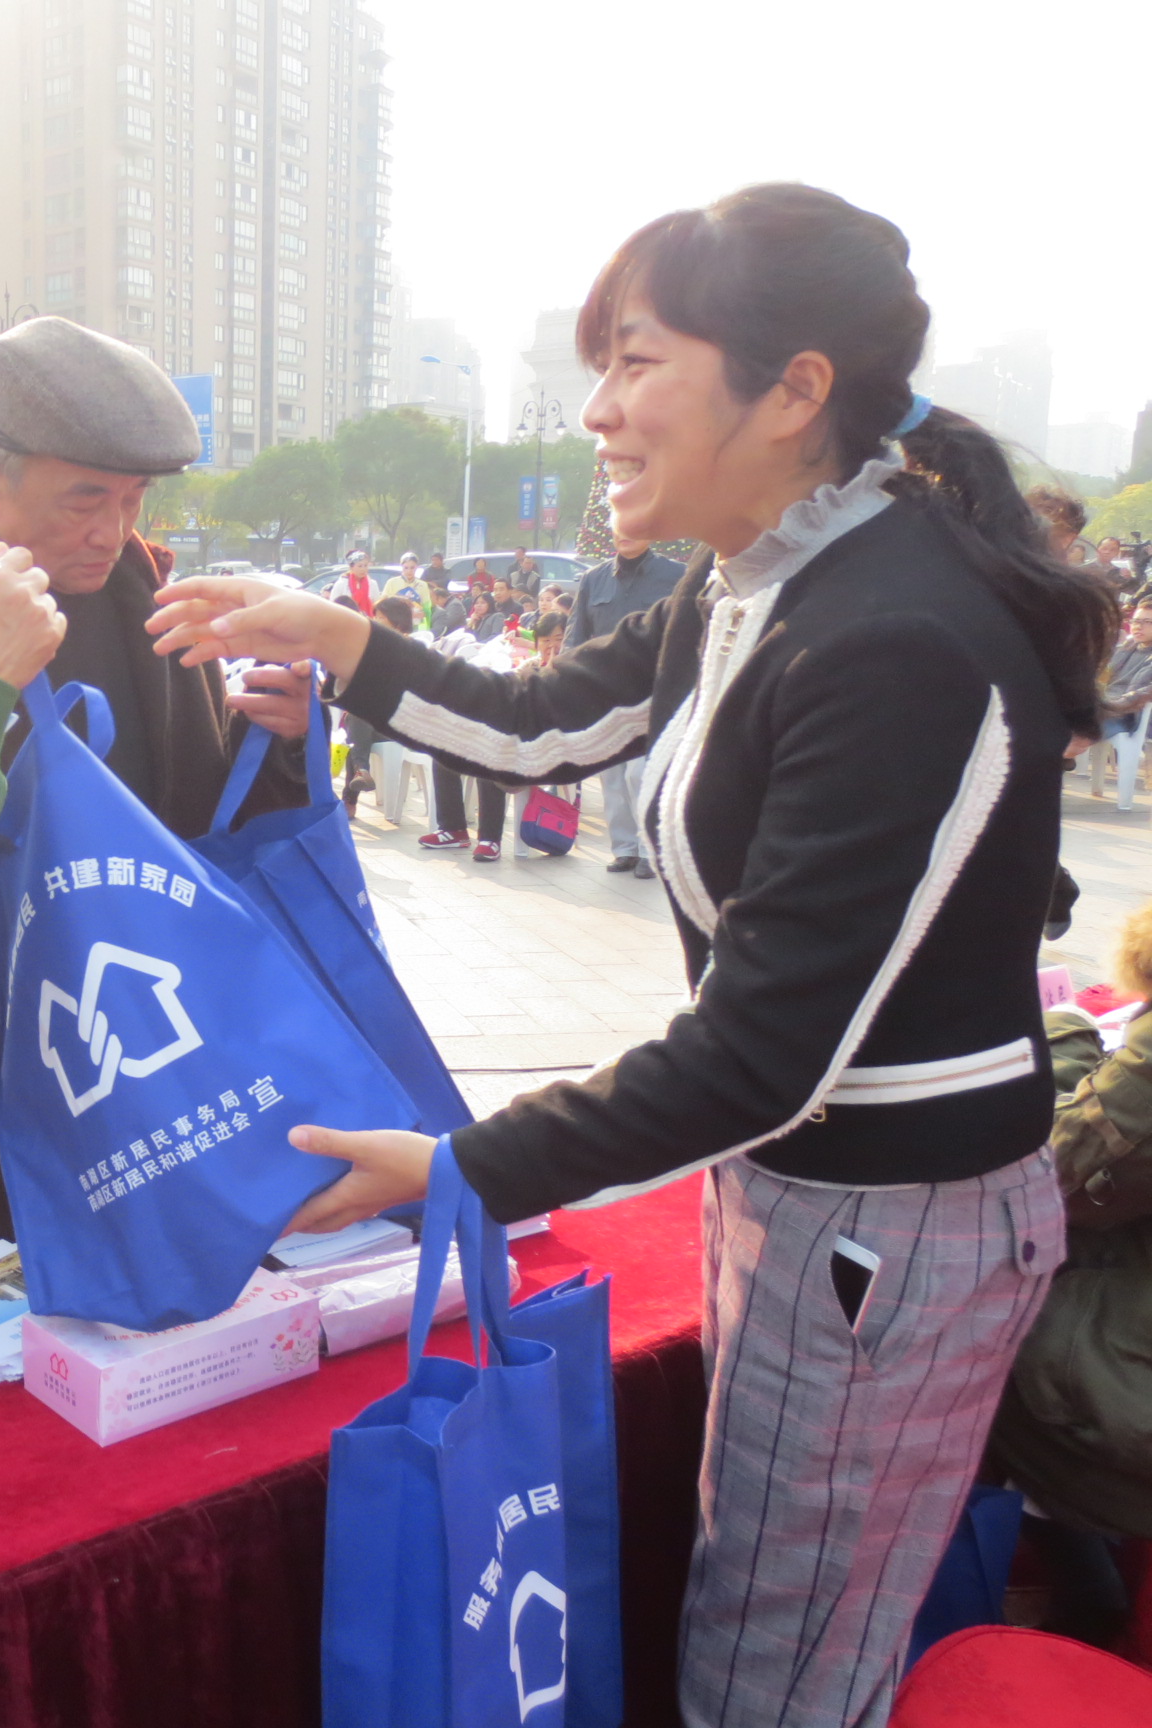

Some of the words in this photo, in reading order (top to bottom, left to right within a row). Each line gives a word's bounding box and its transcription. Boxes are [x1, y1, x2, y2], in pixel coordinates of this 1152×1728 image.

[44, 856, 197, 908] 共建新家园
[78, 1089, 241, 1192] 南湖区新居民事务局
[247, 1075, 285, 1113] 宣
[86, 1111, 251, 1213] 南湖区新居民和谐促进会
[462, 1482, 561, 1632] 服务居民
